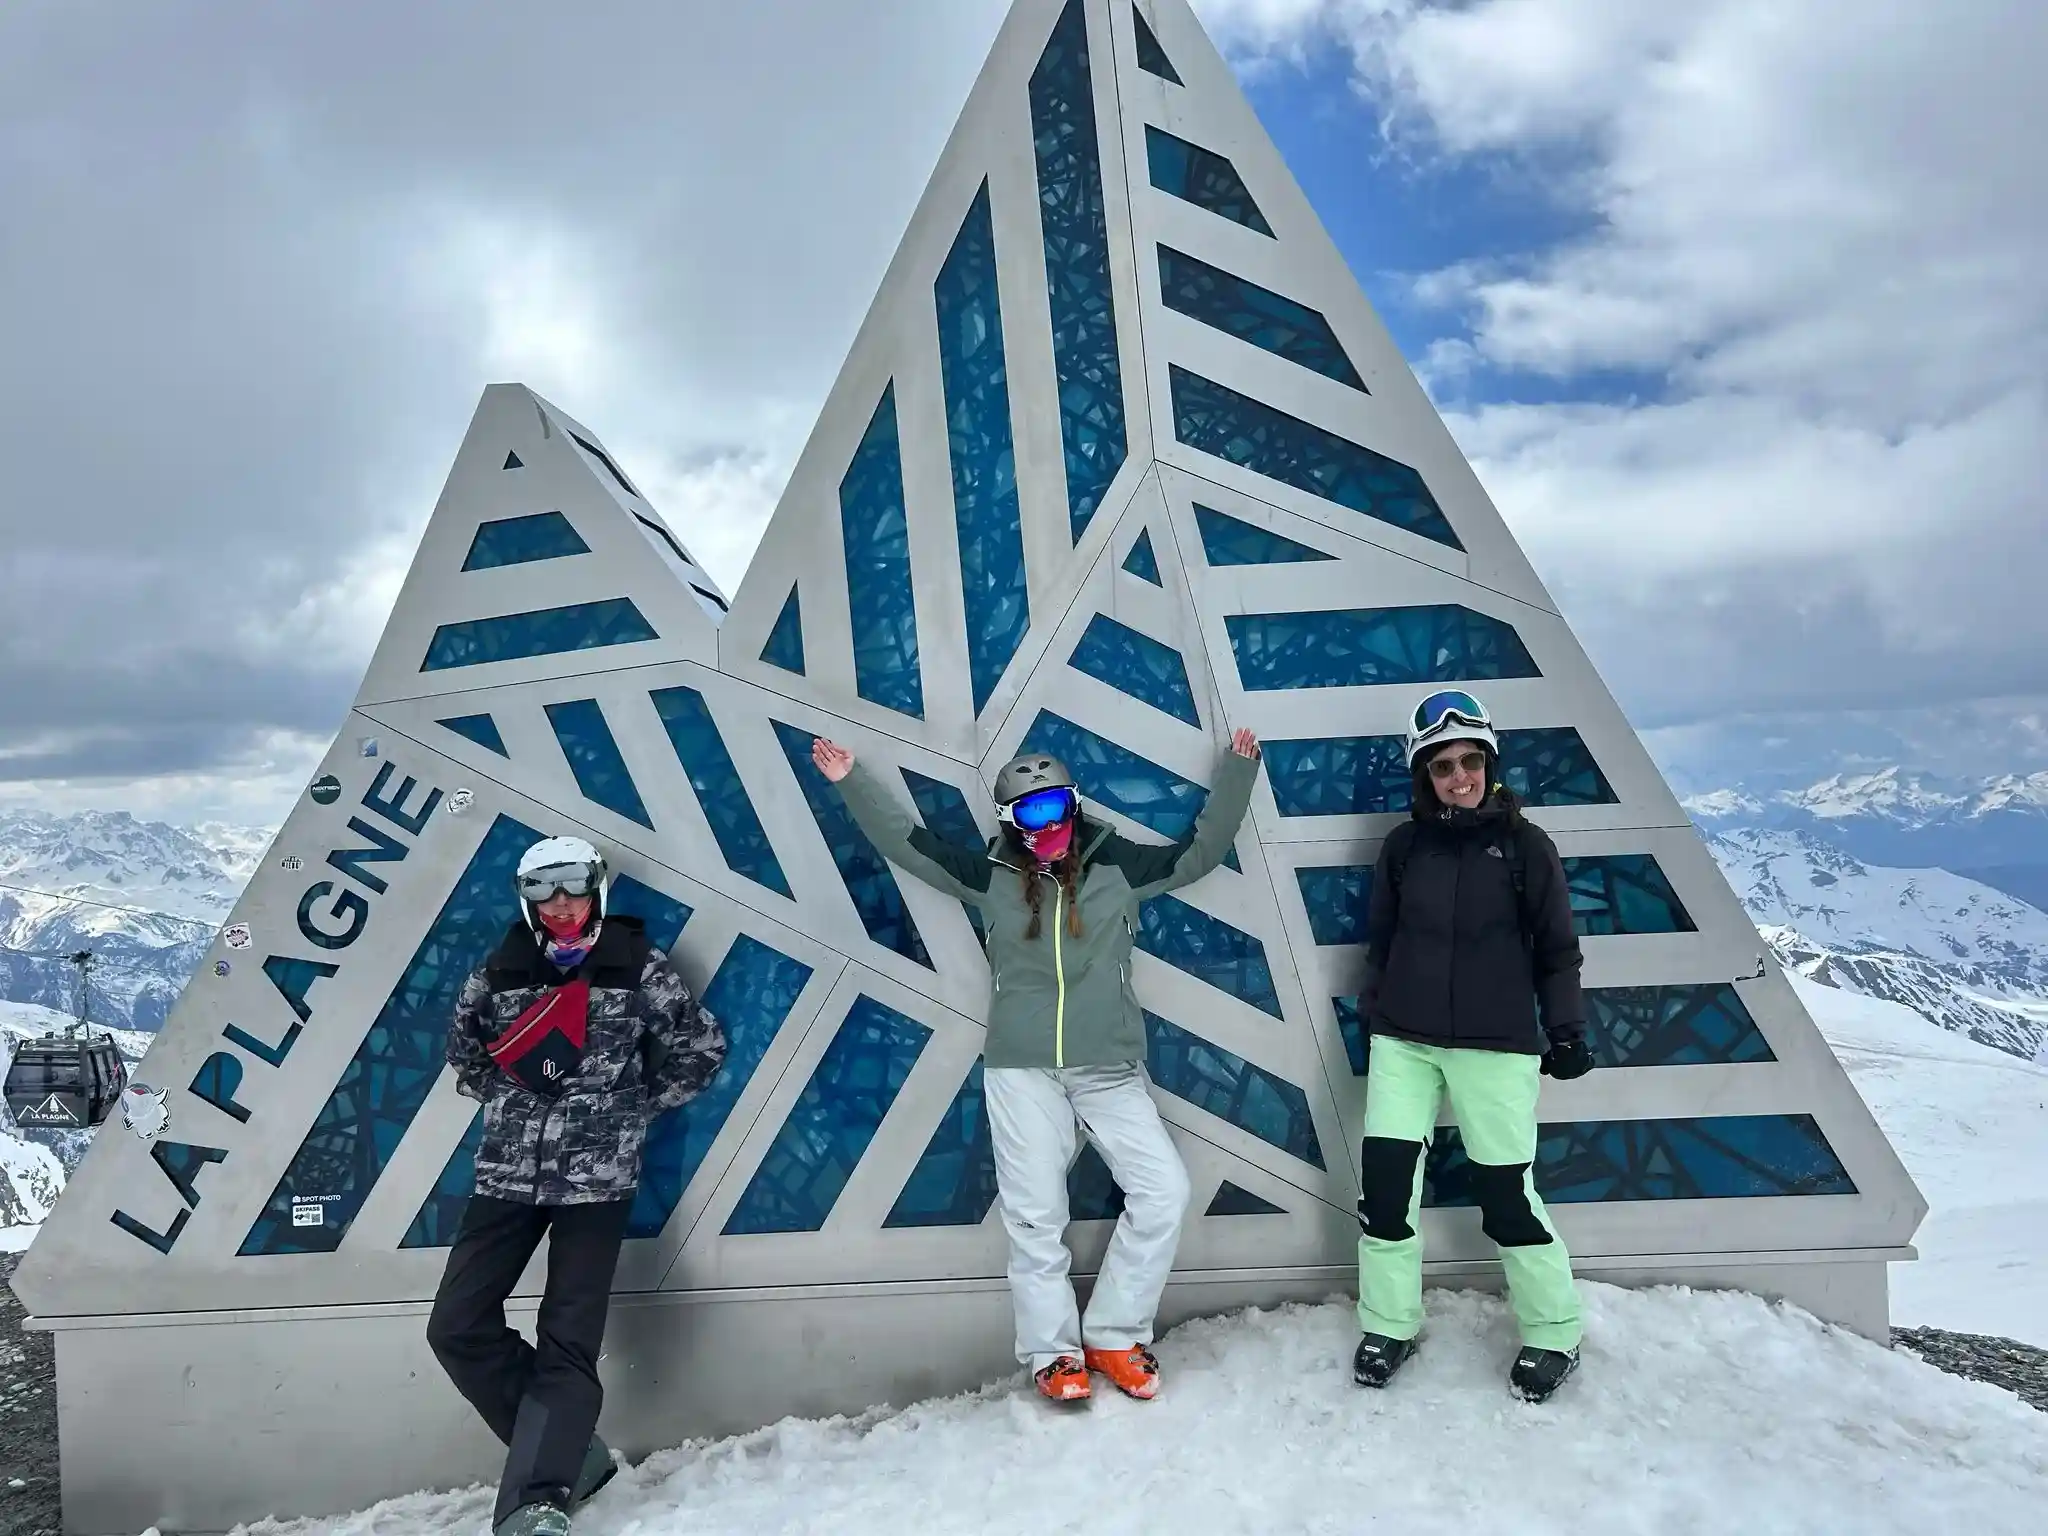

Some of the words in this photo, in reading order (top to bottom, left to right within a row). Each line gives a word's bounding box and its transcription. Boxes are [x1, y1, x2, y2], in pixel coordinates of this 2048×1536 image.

[109, 1140, 229, 1255] LA
[188, 760, 444, 1124] PLAGNE
[302, 1195, 318, 1203] SPOT
